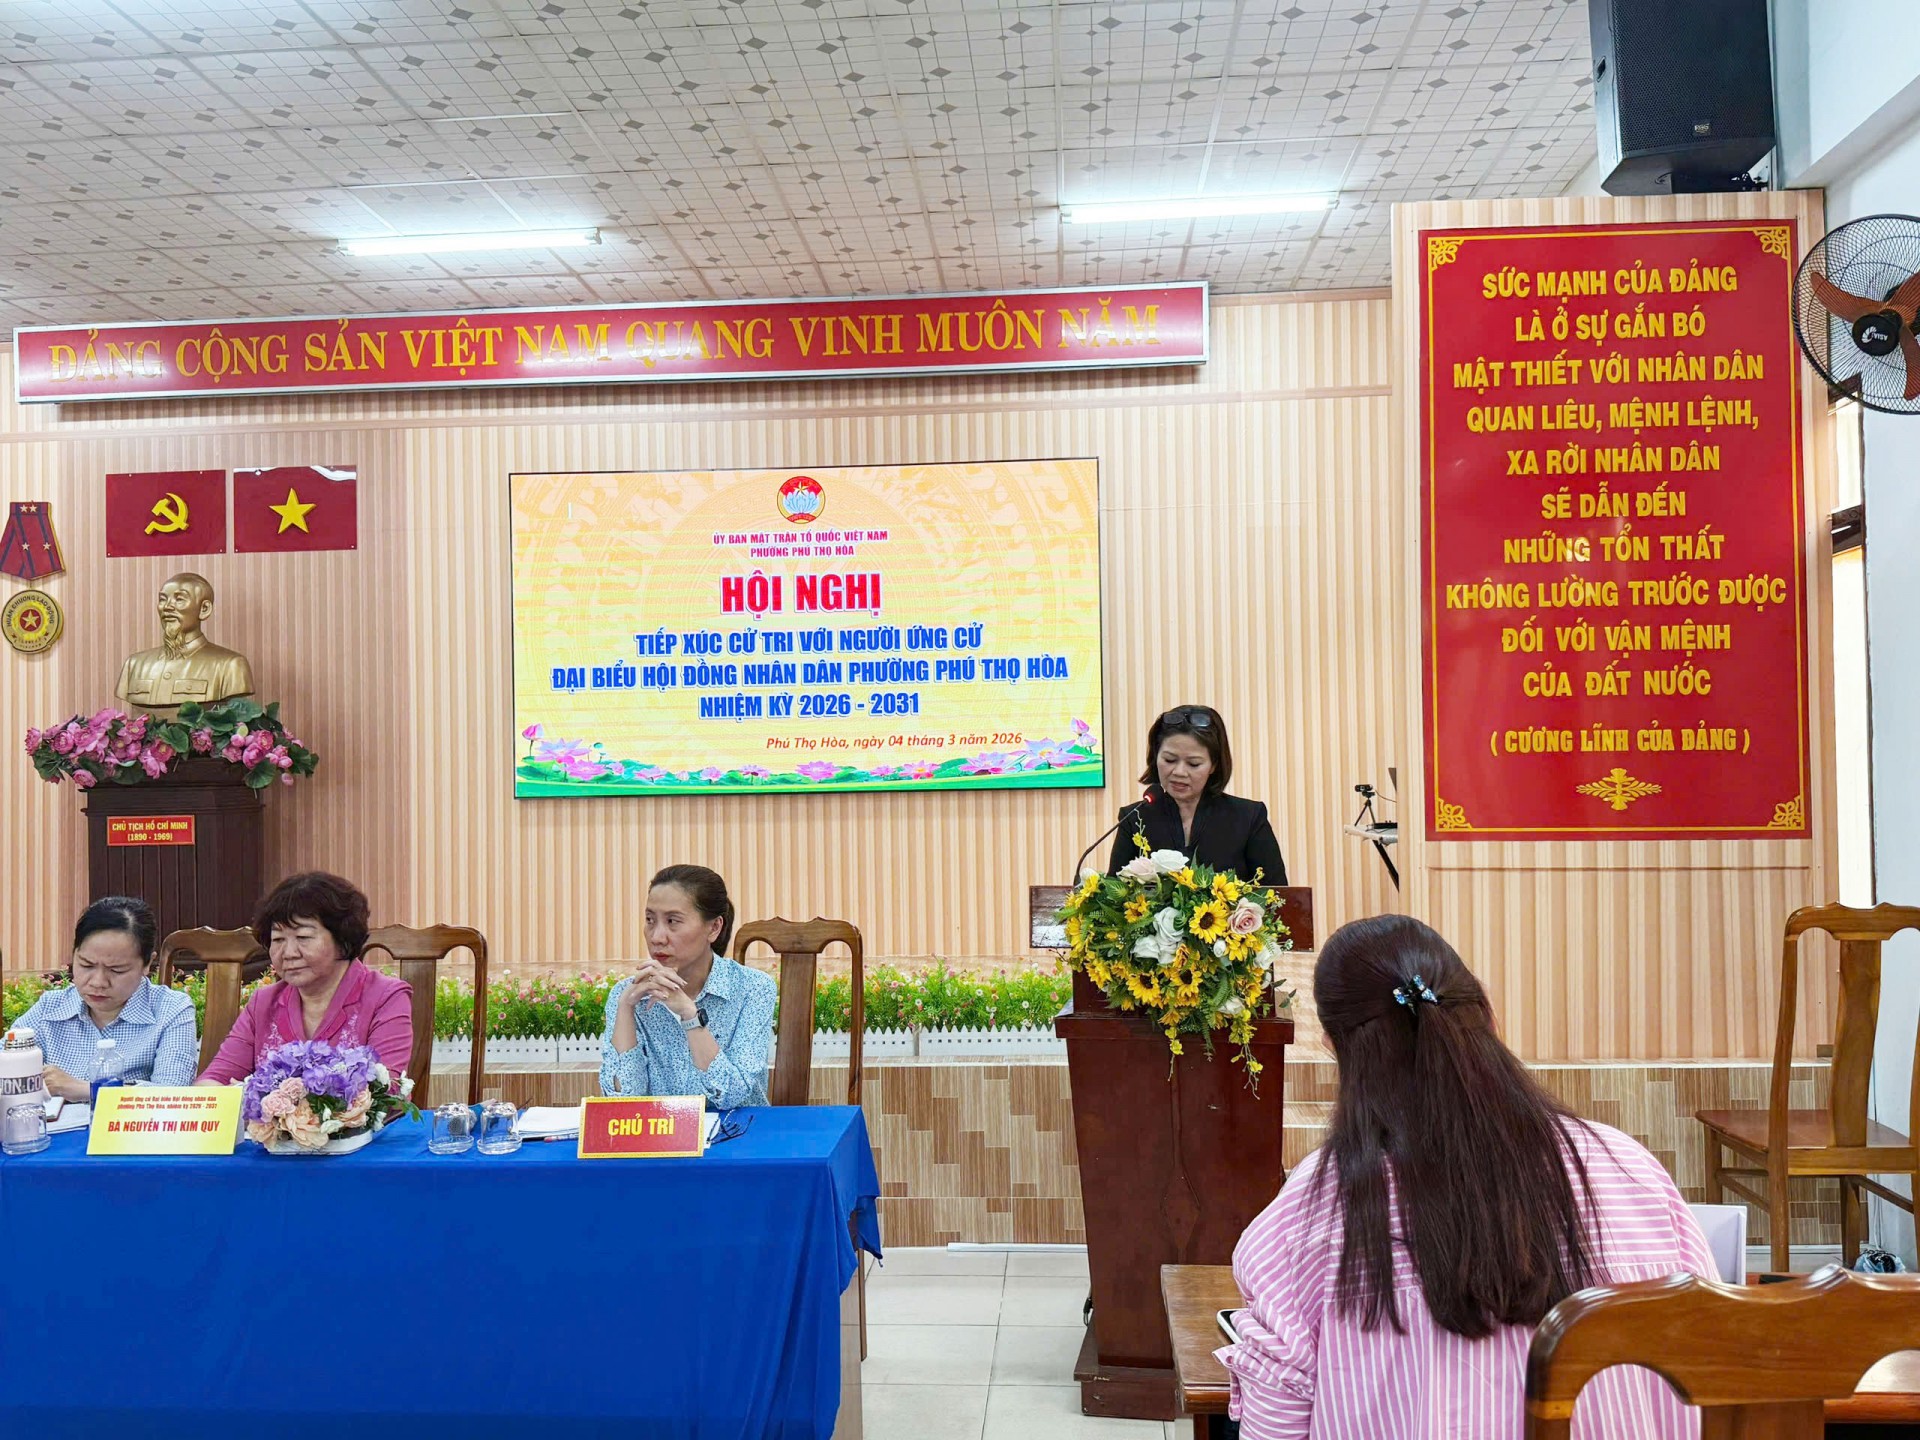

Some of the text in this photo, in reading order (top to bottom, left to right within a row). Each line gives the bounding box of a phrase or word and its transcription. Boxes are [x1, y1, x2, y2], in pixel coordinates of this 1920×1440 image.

[1482, 258, 1738, 303] SỨC MẠNH CỦA ĐẢNG
[48, 297, 1162, 384] ĐẢNG CỘNG SẢN VIỆT NAM QUANG VINH MUÔN NĂM
[1515, 302, 1706, 346] LÀ Ở SỰ GẮN BÓ
[1453, 349, 1764, 394] MẬT THIẾT VỚI NHÂN DÂN
[1466, 394, 1759, 435] QUAN LIÊU, MỆNH LỆNH,
[1506, 440, 1720, 475] XA RỜI NHÂN DÂN
[1541, 481, 1686, 519] SẼ DẪN ĐẾN
[728, 534, 747, 544] BAN
[773, 531, 797, 545] TRẬN
[800, 528, 812, 542] TỔ
[815, 528, 841, 543] QUỐC
[844, 530, 864, 543] VIỆT
[867, 531, 888, 540] NAM
[750, 544, 854, 557] PHƯỜNG PHÚ THỌ HÒA
[1503, 524, 1725, 564] NHỮNG TỔN THẤT
[722, 570, 881, 619] HỘI NGHỊ
[1446, 571, 1786, 612] KHÔNG LƯỜNG TRƯỚC ĐƯỢC
[636, 622, 983, 655] TIẾP XÚC CỬ TRI VỚI NGƯỜI ỨNG CỬ
[1501, 615, 1731, 659] ĐỐI VỚI VẬN MỆNH
[552, 654, 1068, 693] ĐẠI BIỂU HỘI ĐỒNG NHÂN DÂN PHƯỜNG PHÚ THỌ HÒA
[1523, 660, 1711, 697] CỦA ĐẤT NƯỚC
[700, 693, 762, 721] NHIỆM
[769, 691, 794, 716] KỲ
[799, 694, 850, 715] 2026
[870, 692, 919, 714] 2031
[766, 733, 1022, 750] Phú Thọ Hòa, ngày 04 tháng 3 năm 2026
[1580, 722, 1629, 752] LĨNH
[1637, 720, 1675, 751] CỦA
[112, 820, 126, 831] CHỦ
[128, 822, 144, 832] TỊCH
[157, 820, 169, 830] CHÍ
[170, 821, 188, 829] MINH
[162, 1121, 178, 1133] THỊ
[180, 1121, 198, 1131] KIM
[608, 1113, 675, 1136] CHỦ TRÌ
